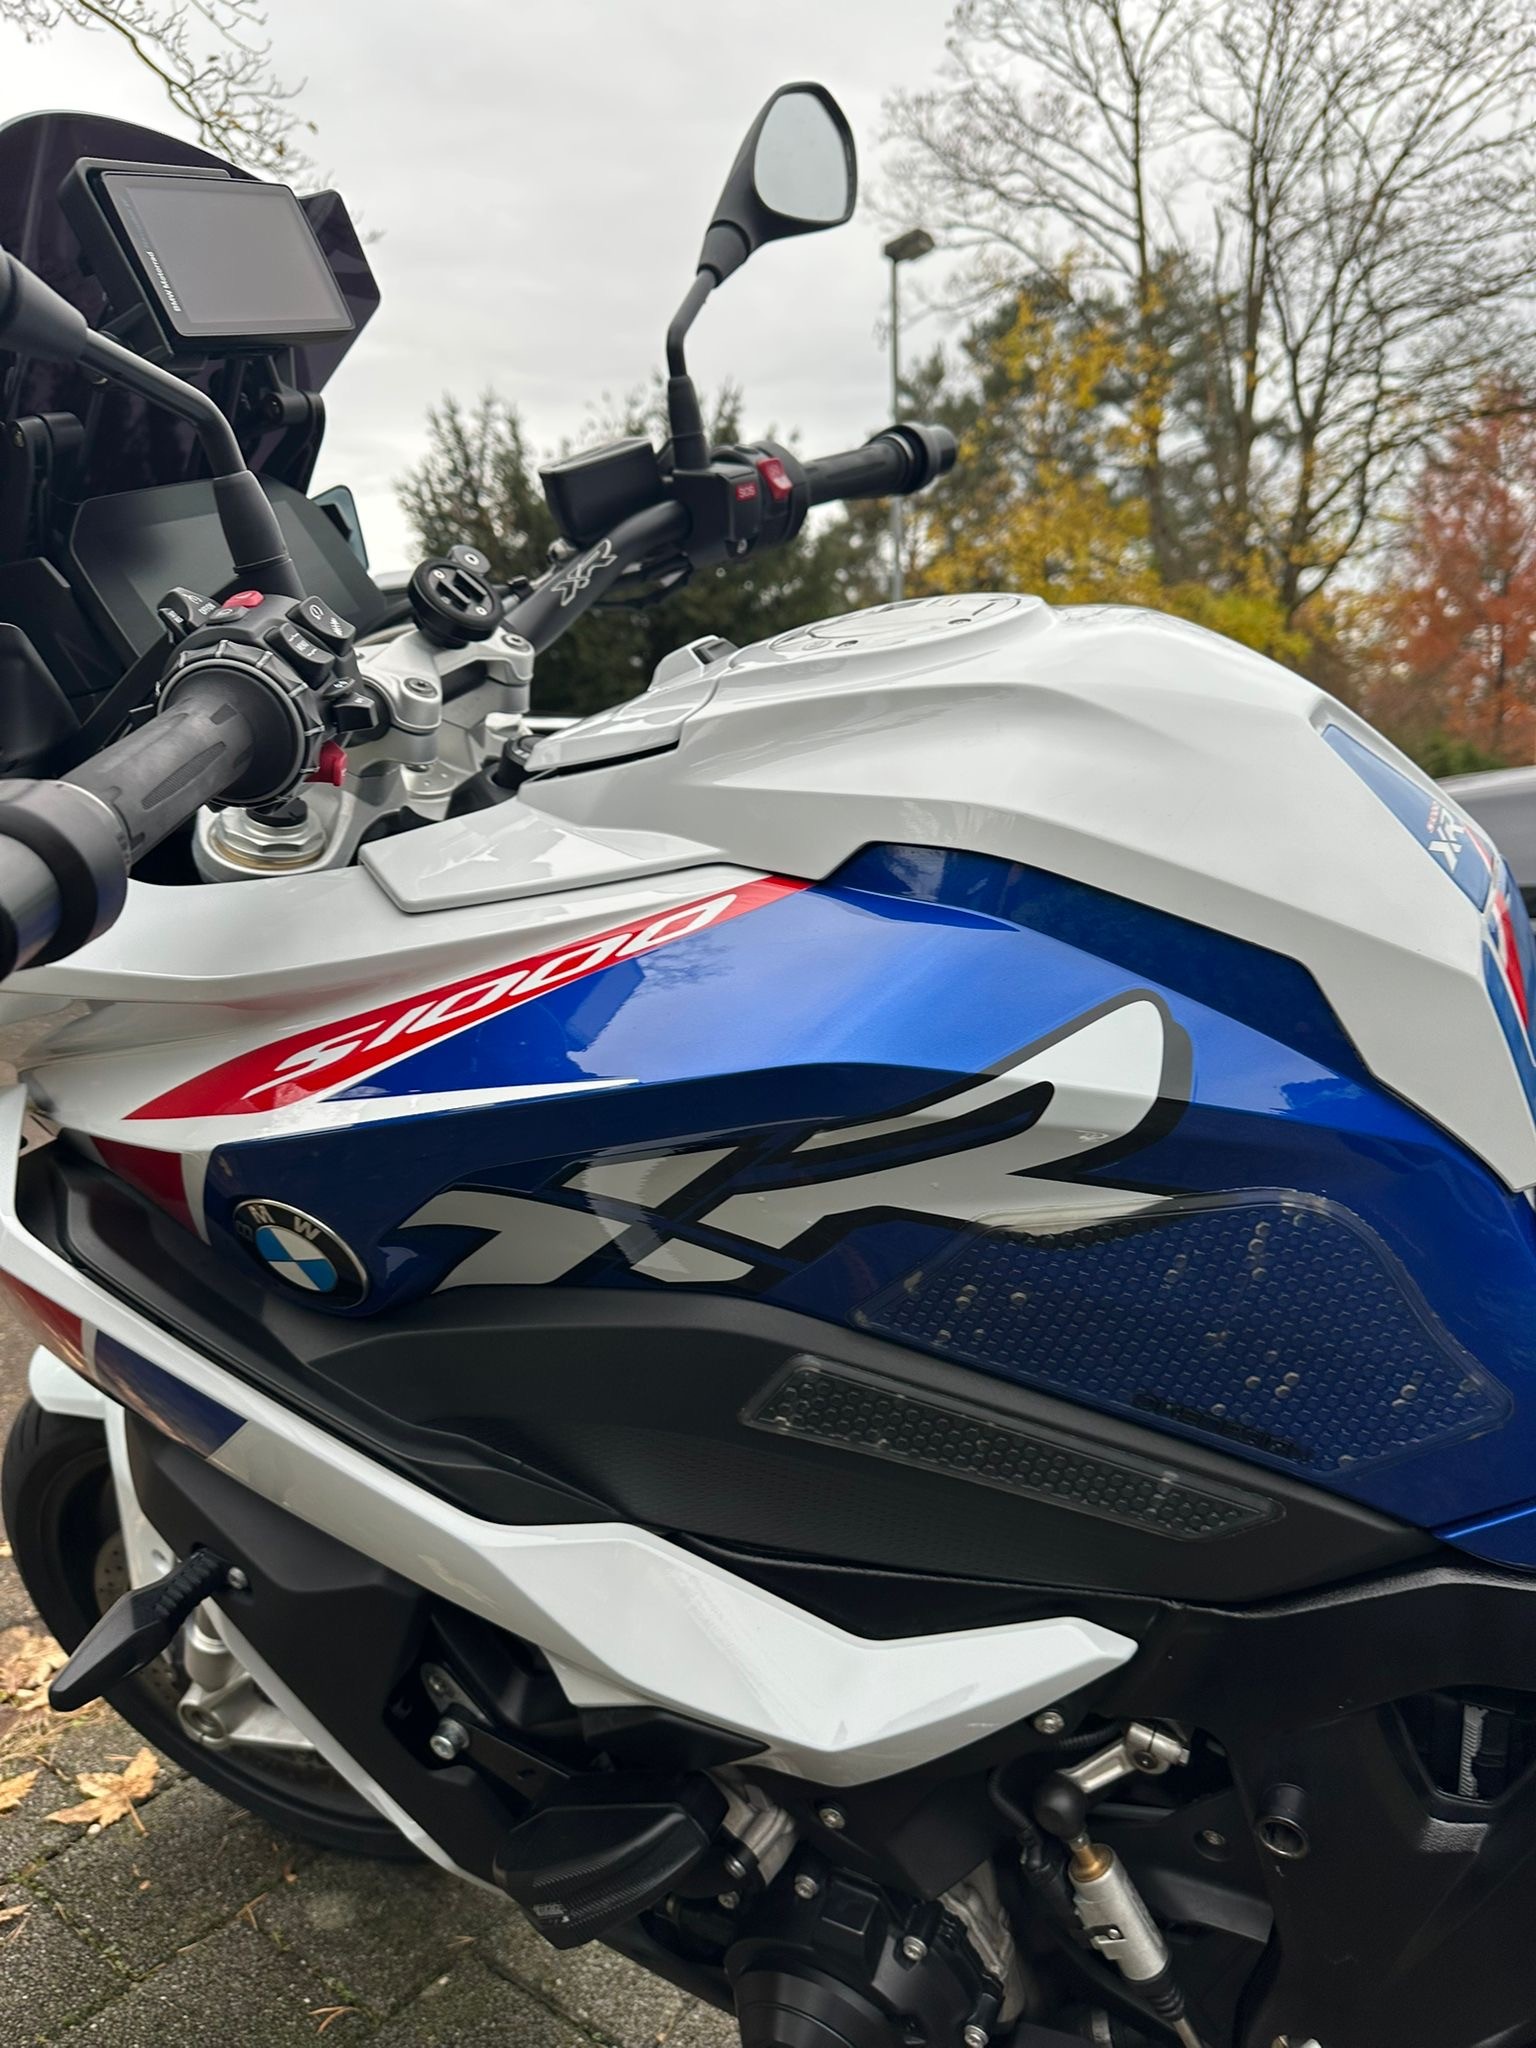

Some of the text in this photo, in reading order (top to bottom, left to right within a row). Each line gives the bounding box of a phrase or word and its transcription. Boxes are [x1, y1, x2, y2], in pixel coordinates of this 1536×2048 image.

[164, 289, 182, 312] BMW
[738, 485, 756, 499] SOS
[550, 538, 618, 607] XR
[241, 893, 738, 1101] S1000
[397, 999, 1175, 1296] XR
